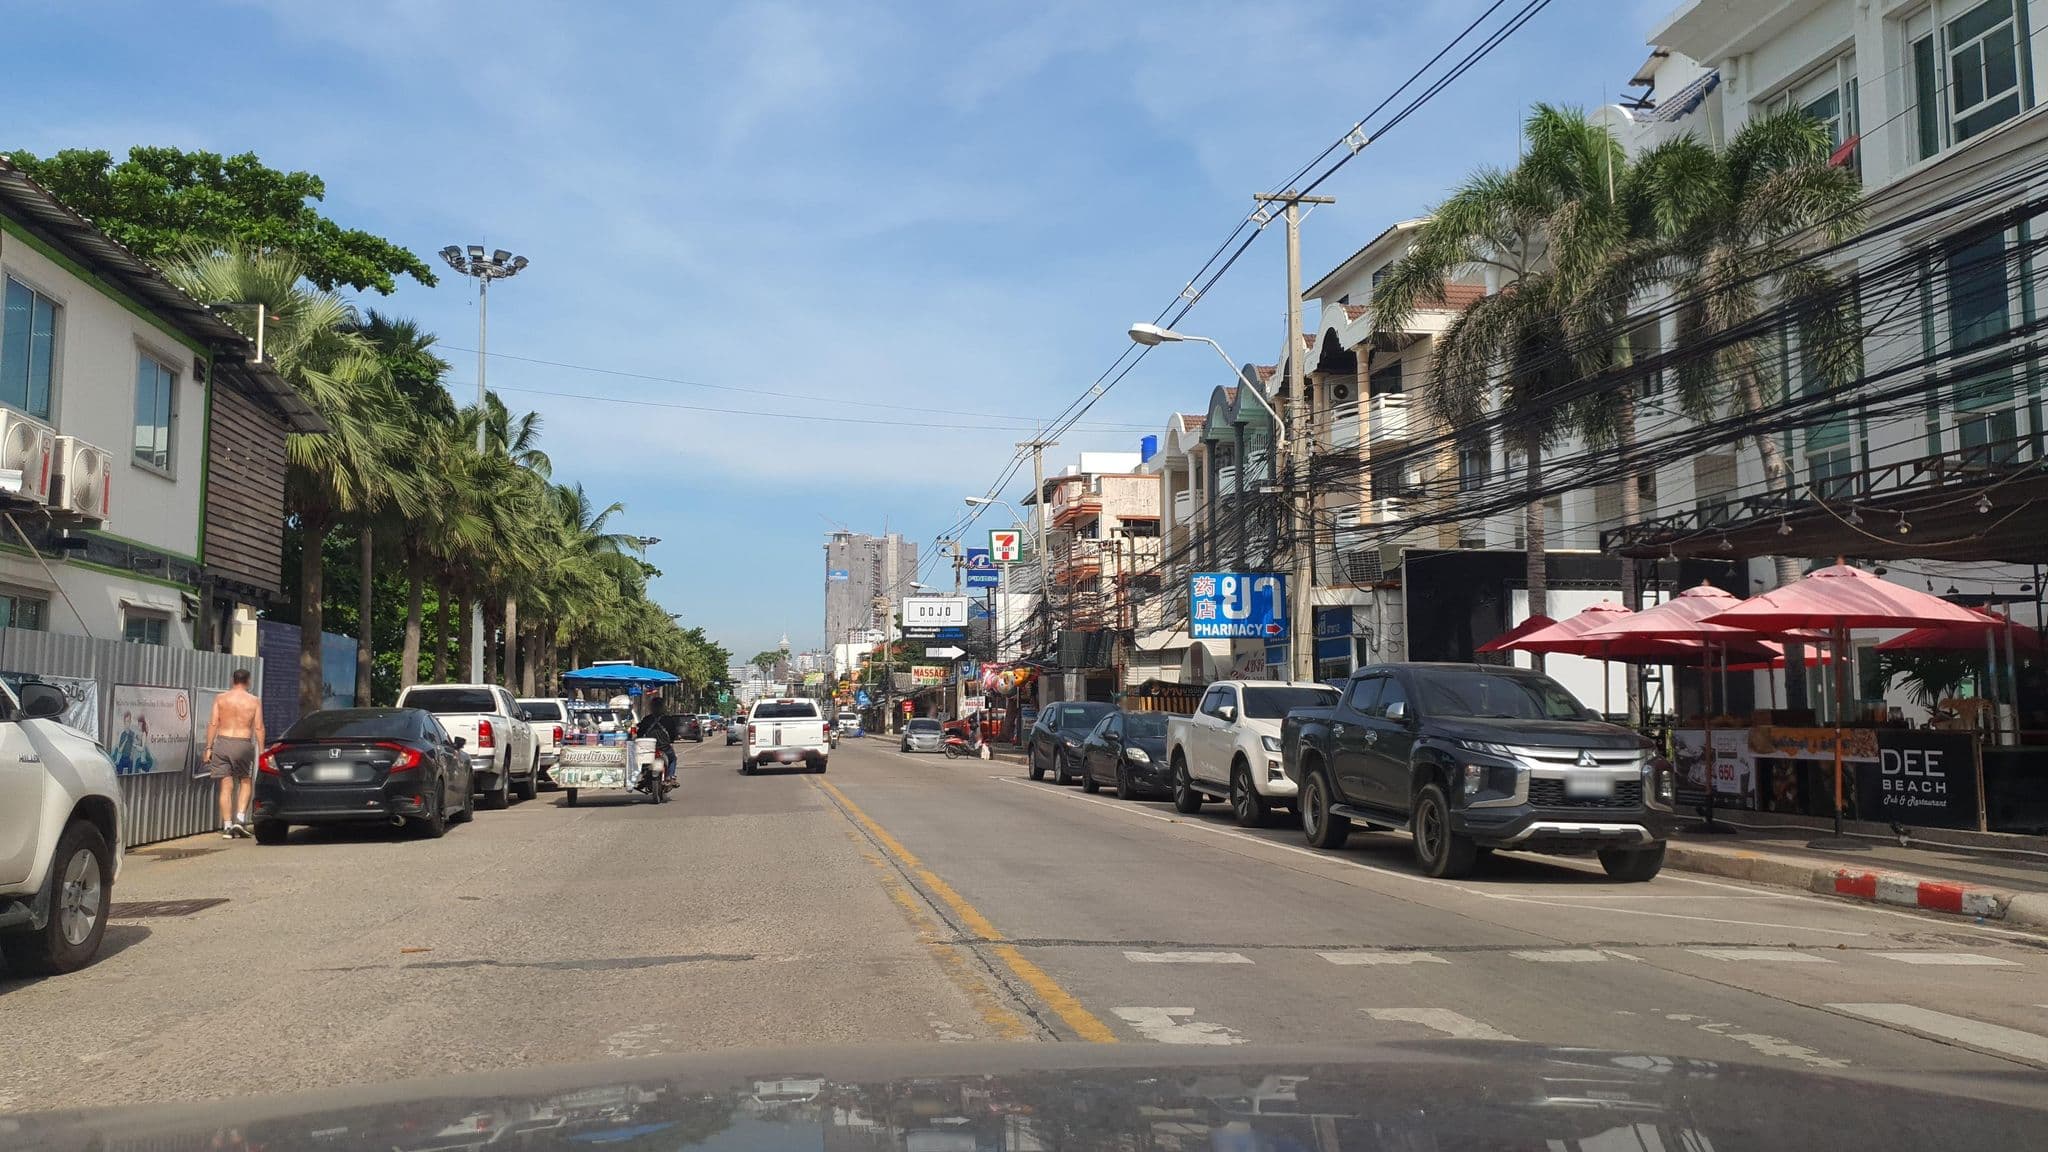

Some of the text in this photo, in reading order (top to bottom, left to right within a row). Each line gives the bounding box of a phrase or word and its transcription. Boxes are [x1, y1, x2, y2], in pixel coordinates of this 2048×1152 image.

[995, 534, 1014, 560] 7
[1193, 576, 1216, 620] 药店
[1221, 576, 1282, 619] ยา
[920, 606, 951, 617] DOJO
[1194, 623, 1262, 636] PHARMACY
[913, 668, 949, 678] MASSAGE
[1881, 749, 1945, 777] DEE
[1882, 779, 1947, 793] BEACH
